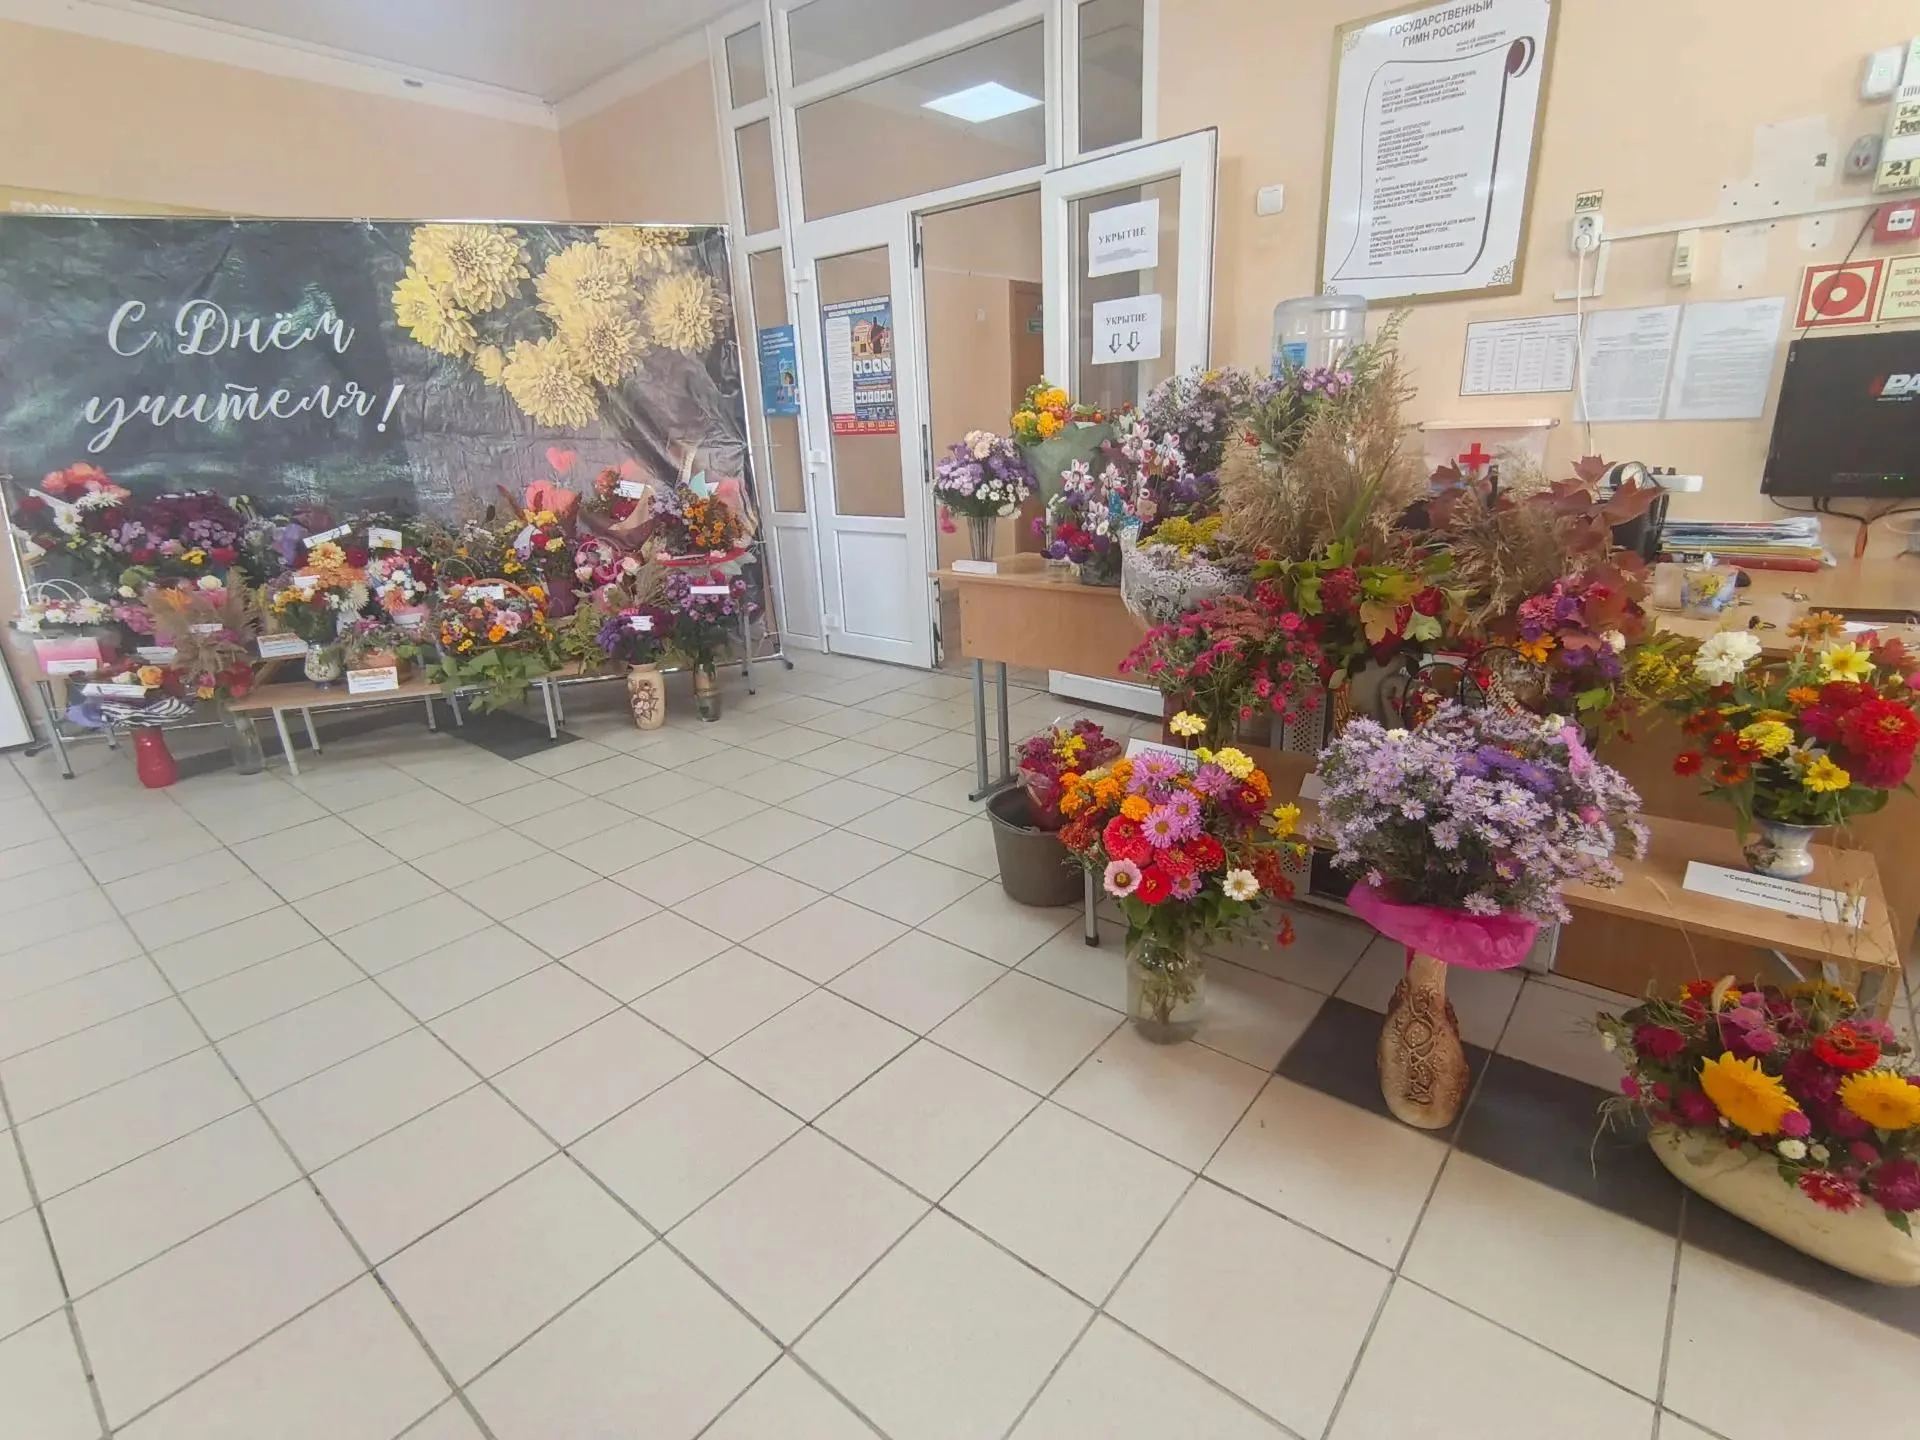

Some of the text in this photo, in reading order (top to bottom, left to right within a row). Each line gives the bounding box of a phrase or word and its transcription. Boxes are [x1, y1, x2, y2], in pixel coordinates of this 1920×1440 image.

[1402, 18, 1475, 48] ГИМН РОССИИ
[1098, 226, 1147, 246] УКРЫТИЕ
[107, 298, 356, 357] С Днём
[1105, 312, 1149, 327] УКРЫТИЕ
[84, 381, 406, 454] учителя!
